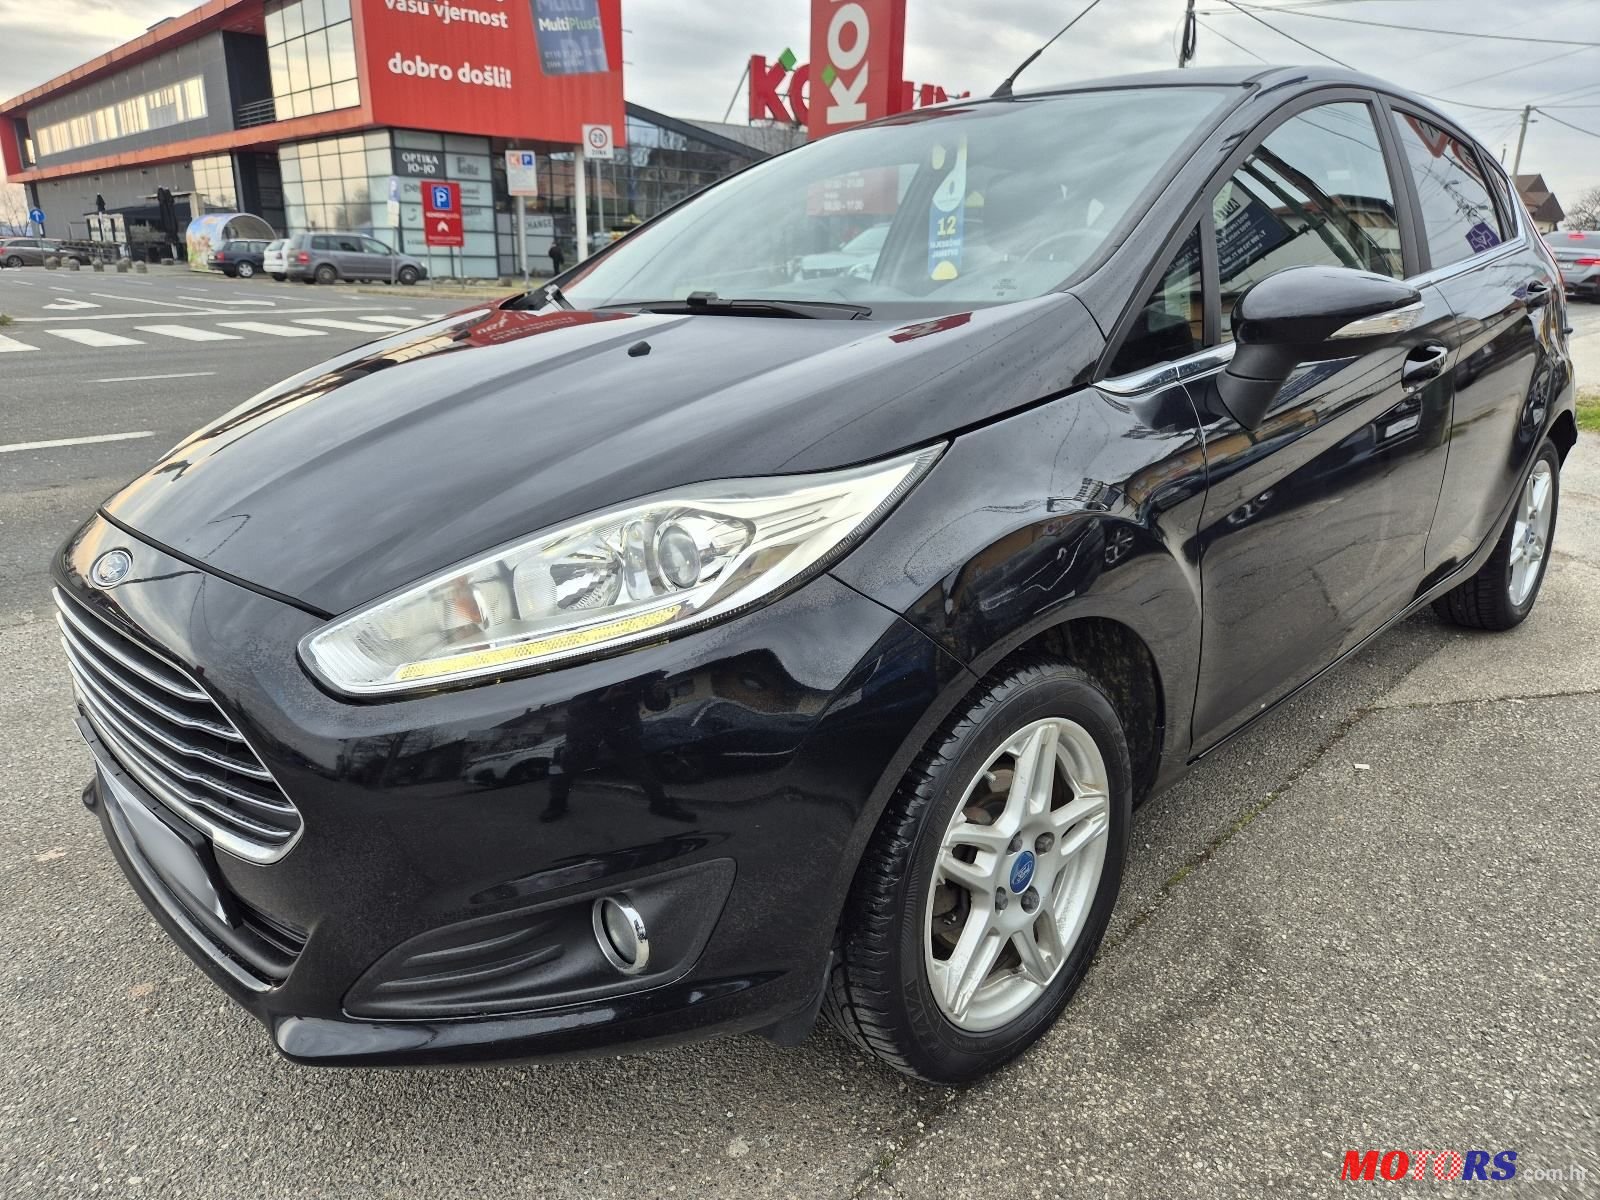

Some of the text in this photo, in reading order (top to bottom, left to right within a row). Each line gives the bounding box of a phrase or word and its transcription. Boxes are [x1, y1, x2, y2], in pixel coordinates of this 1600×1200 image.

[434, 3, 509, 29] vjernost
[388, 52, 512, 89] dobro došli!
[401, 152, 439, 165] OPTIKA
[936, 215, 957, 236] 12
